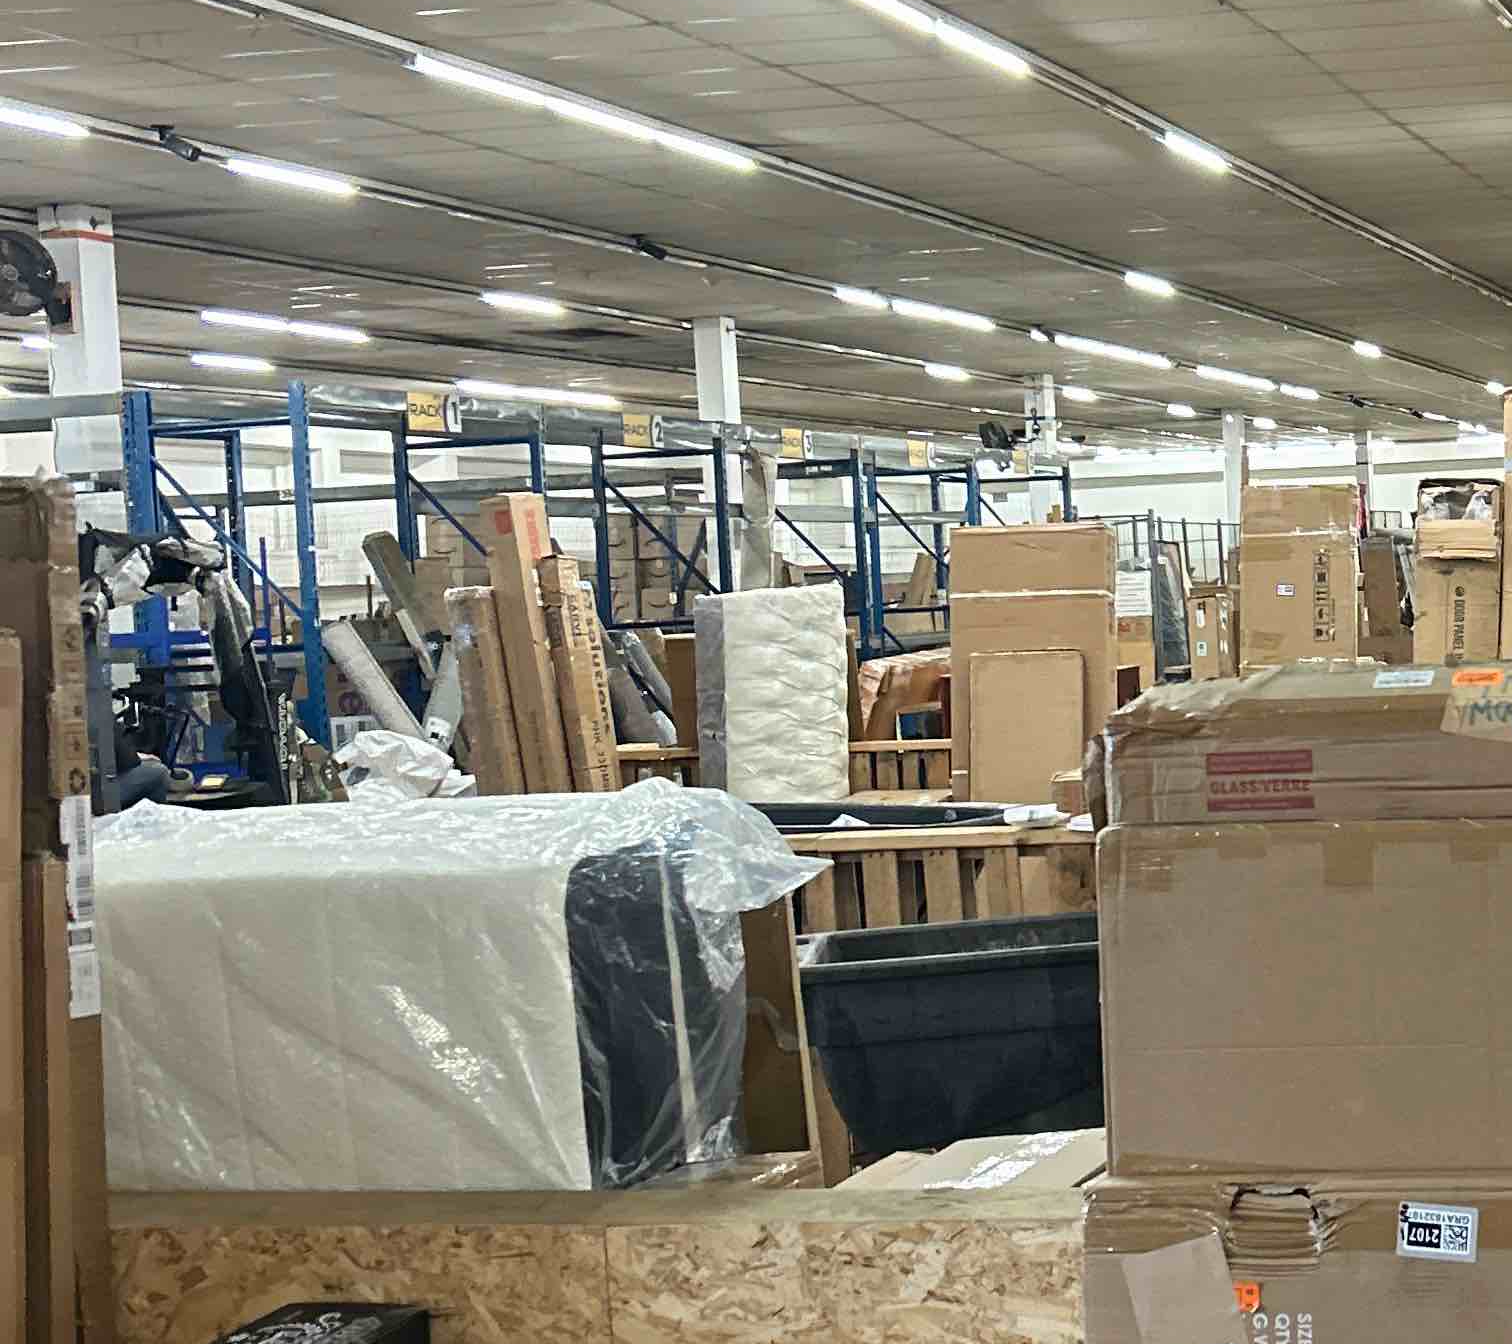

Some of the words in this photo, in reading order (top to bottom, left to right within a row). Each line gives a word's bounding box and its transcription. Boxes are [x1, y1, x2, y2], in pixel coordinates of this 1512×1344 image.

[409, 401, 441, 421] RACK
[652, 420, 663, 442] 2
[1408, 1226, 1441, 1244] 2107
